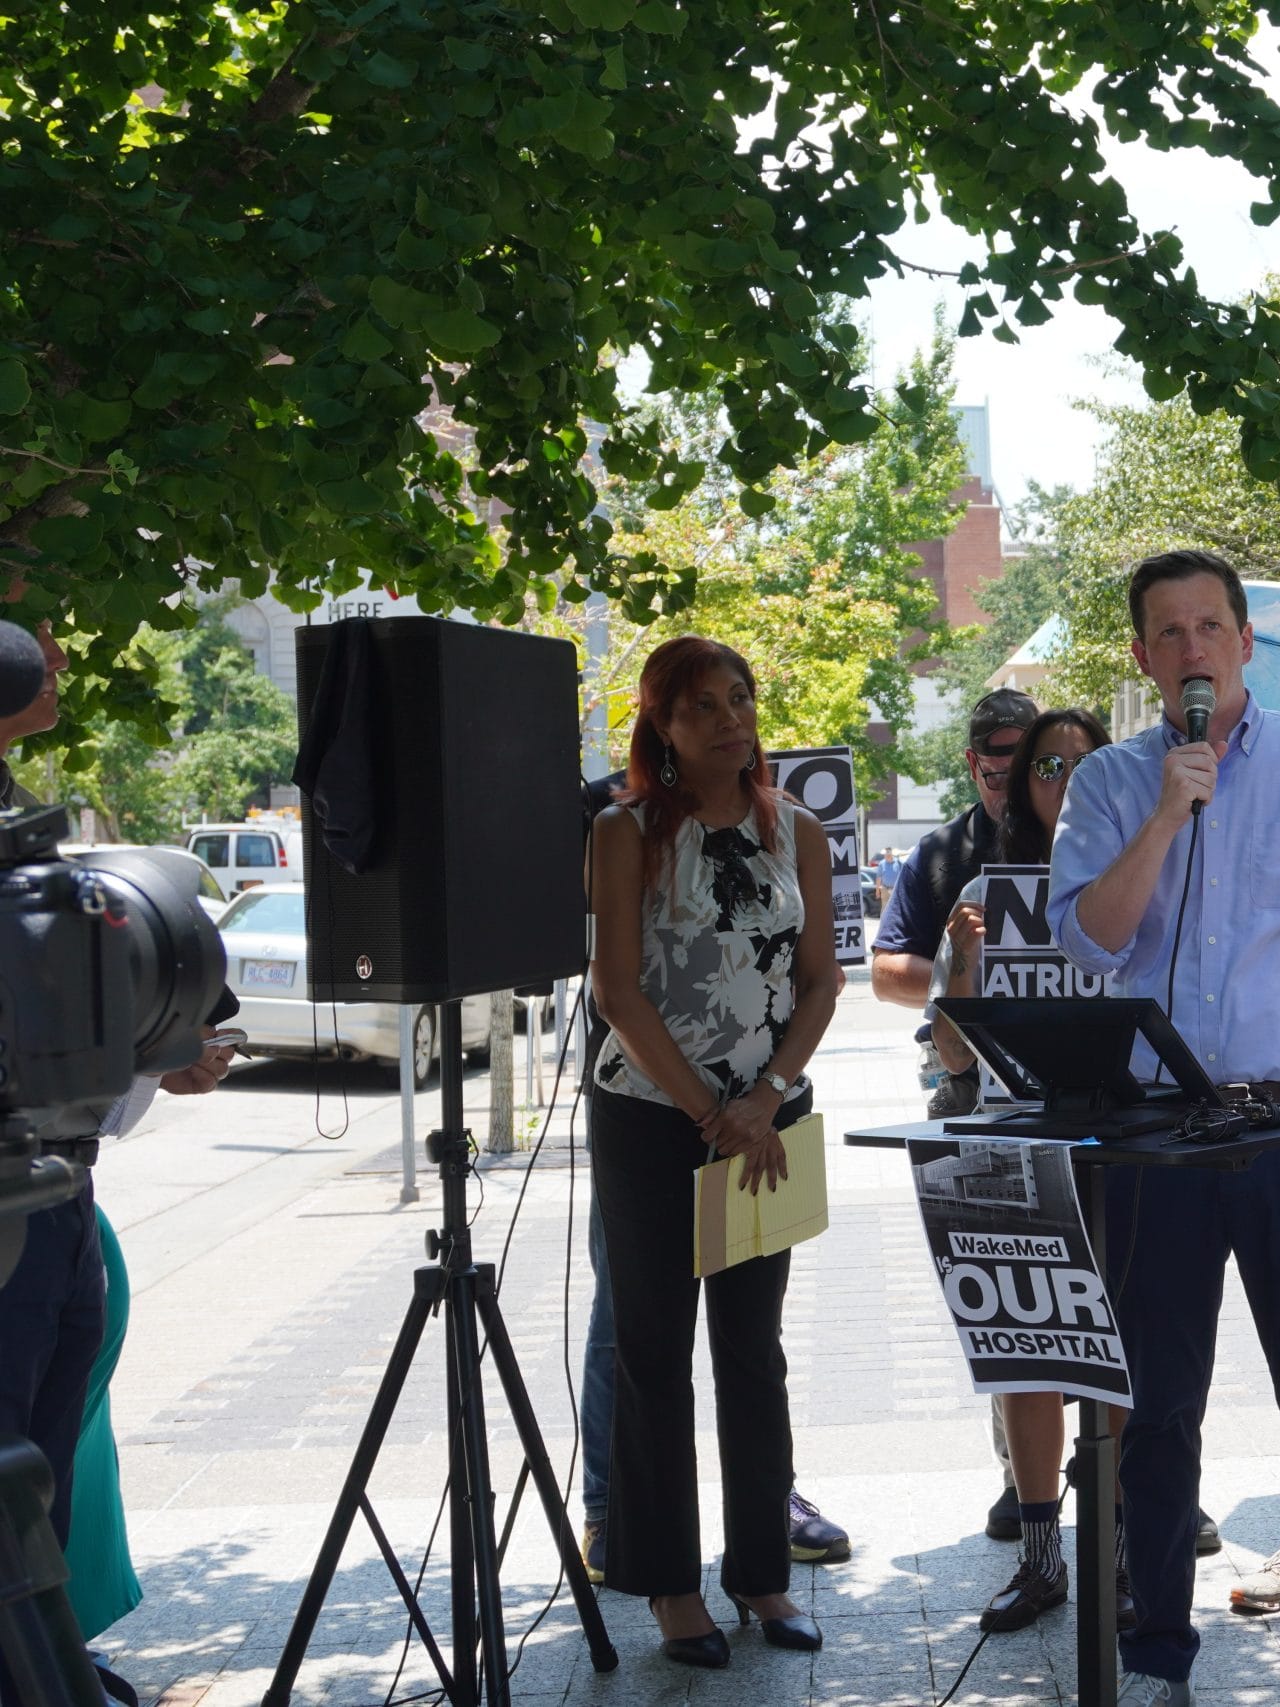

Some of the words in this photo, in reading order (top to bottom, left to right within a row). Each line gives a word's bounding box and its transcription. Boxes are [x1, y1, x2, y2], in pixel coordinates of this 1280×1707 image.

[328, 602, 384, 622] HERE
[767, 757, 853, 822] O
[954, 1235, 1063, 1259] WakeMed
[944, 1263, 1111, 1328] OUR
[968, 1331, 1121, 1364] HOSPITAL
